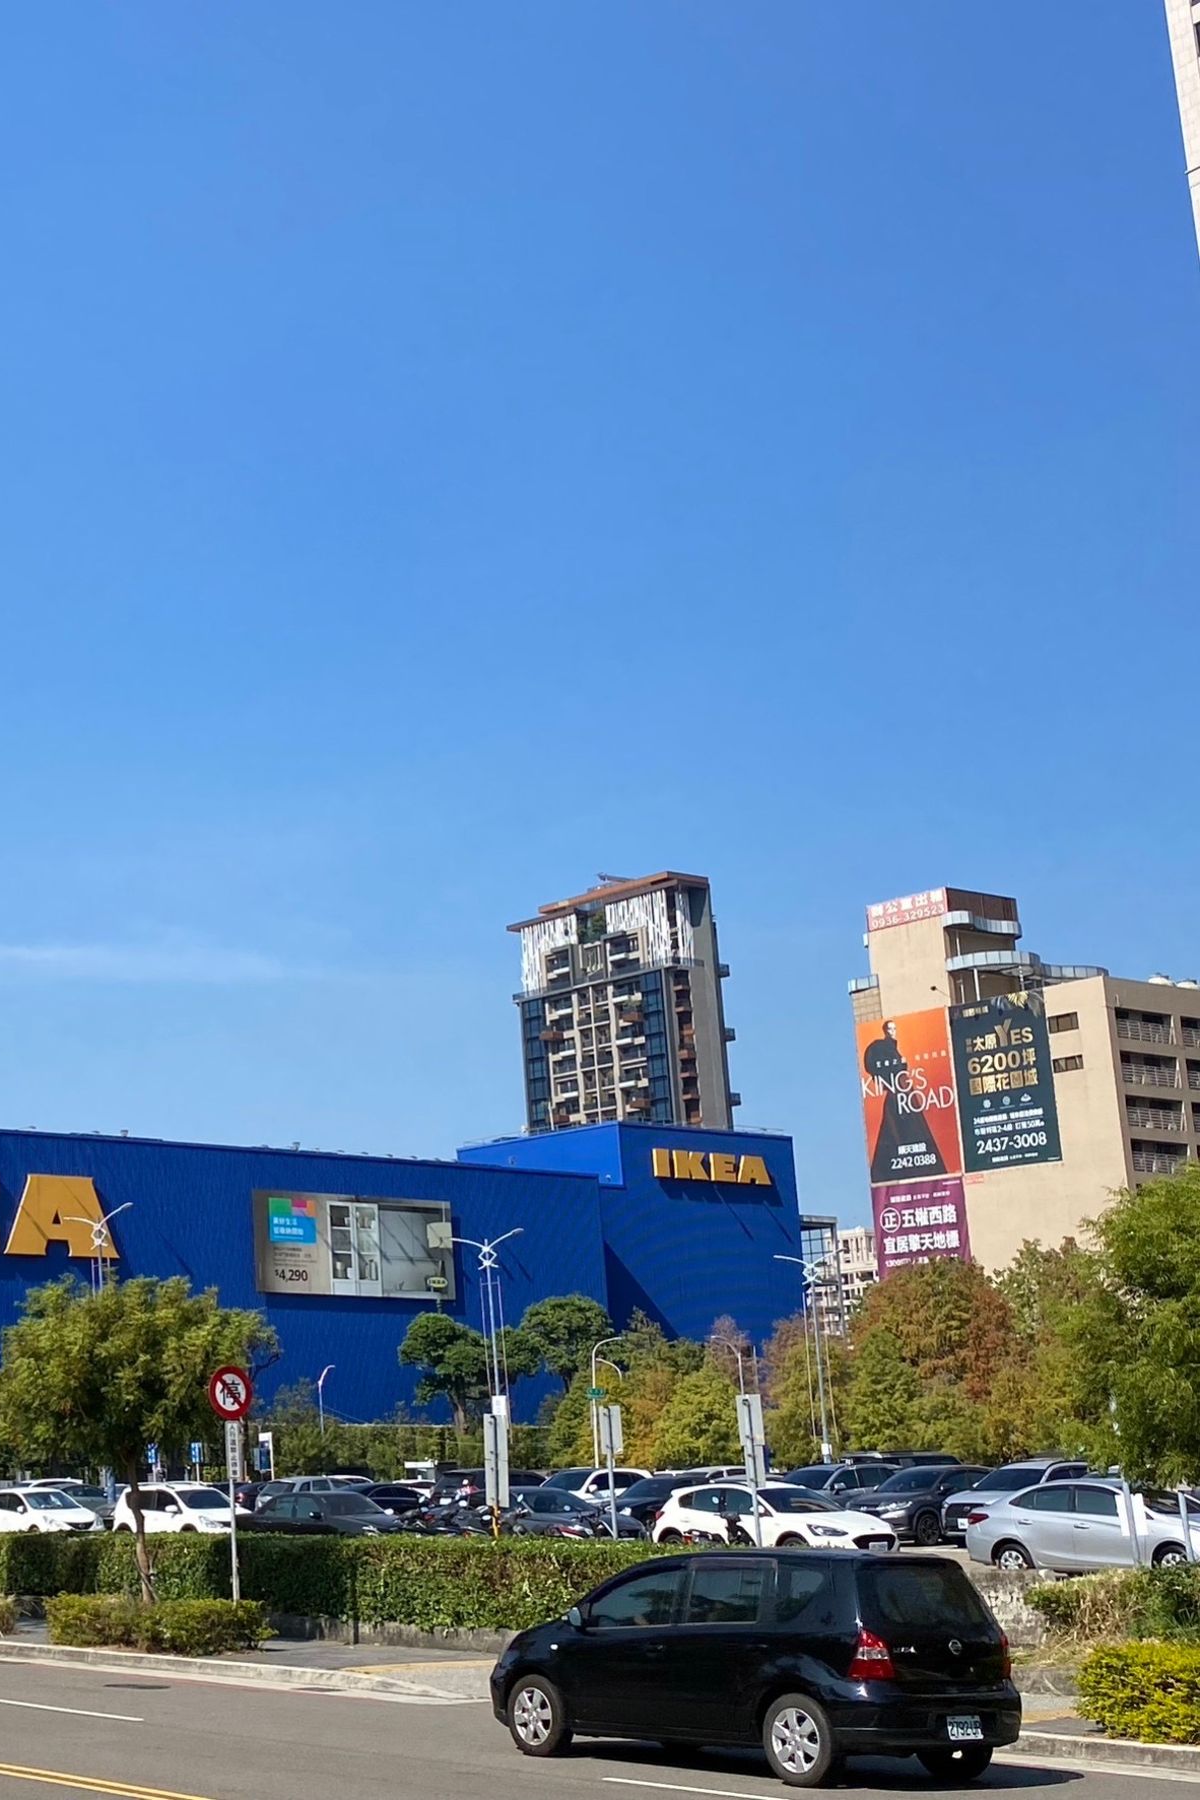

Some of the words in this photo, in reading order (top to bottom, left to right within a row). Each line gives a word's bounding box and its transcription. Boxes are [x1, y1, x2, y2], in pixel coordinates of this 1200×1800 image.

[861, 1068, 928, 1098] KING'S
[897, 1086, 954, 1115] ROAD
[976, 1131, 1047, 1155] 2437-3008
[652, 1148, 773, 1185] IKEA
[274, 1269, 308, 1282] $4,290
[220, 1380, 241, 1405] 停
